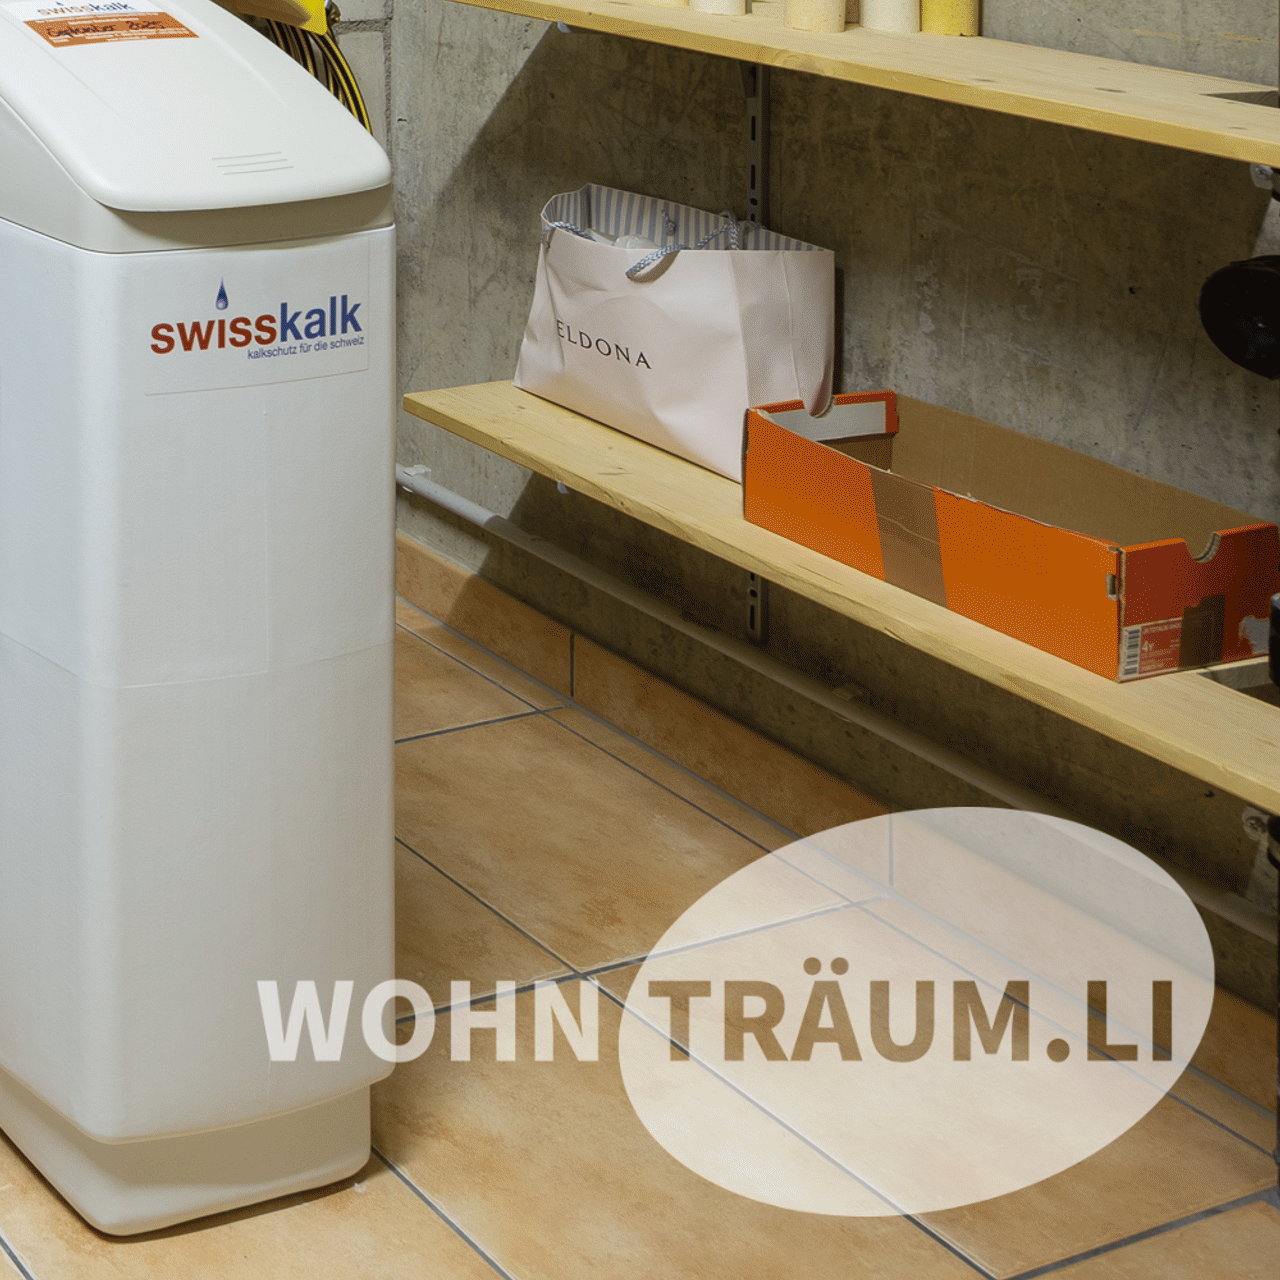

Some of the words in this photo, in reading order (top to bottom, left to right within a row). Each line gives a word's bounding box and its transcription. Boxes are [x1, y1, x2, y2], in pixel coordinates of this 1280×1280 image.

[37, 1, 136, 17] swisskalk
[149, 293, 363, 355] swisskalk
[247, 344, 297, 360] kalkschutz
[299, 342, 313, 354] für
[313, 340, 328, 353] die
[330, 335, 365, 351] schweiz
